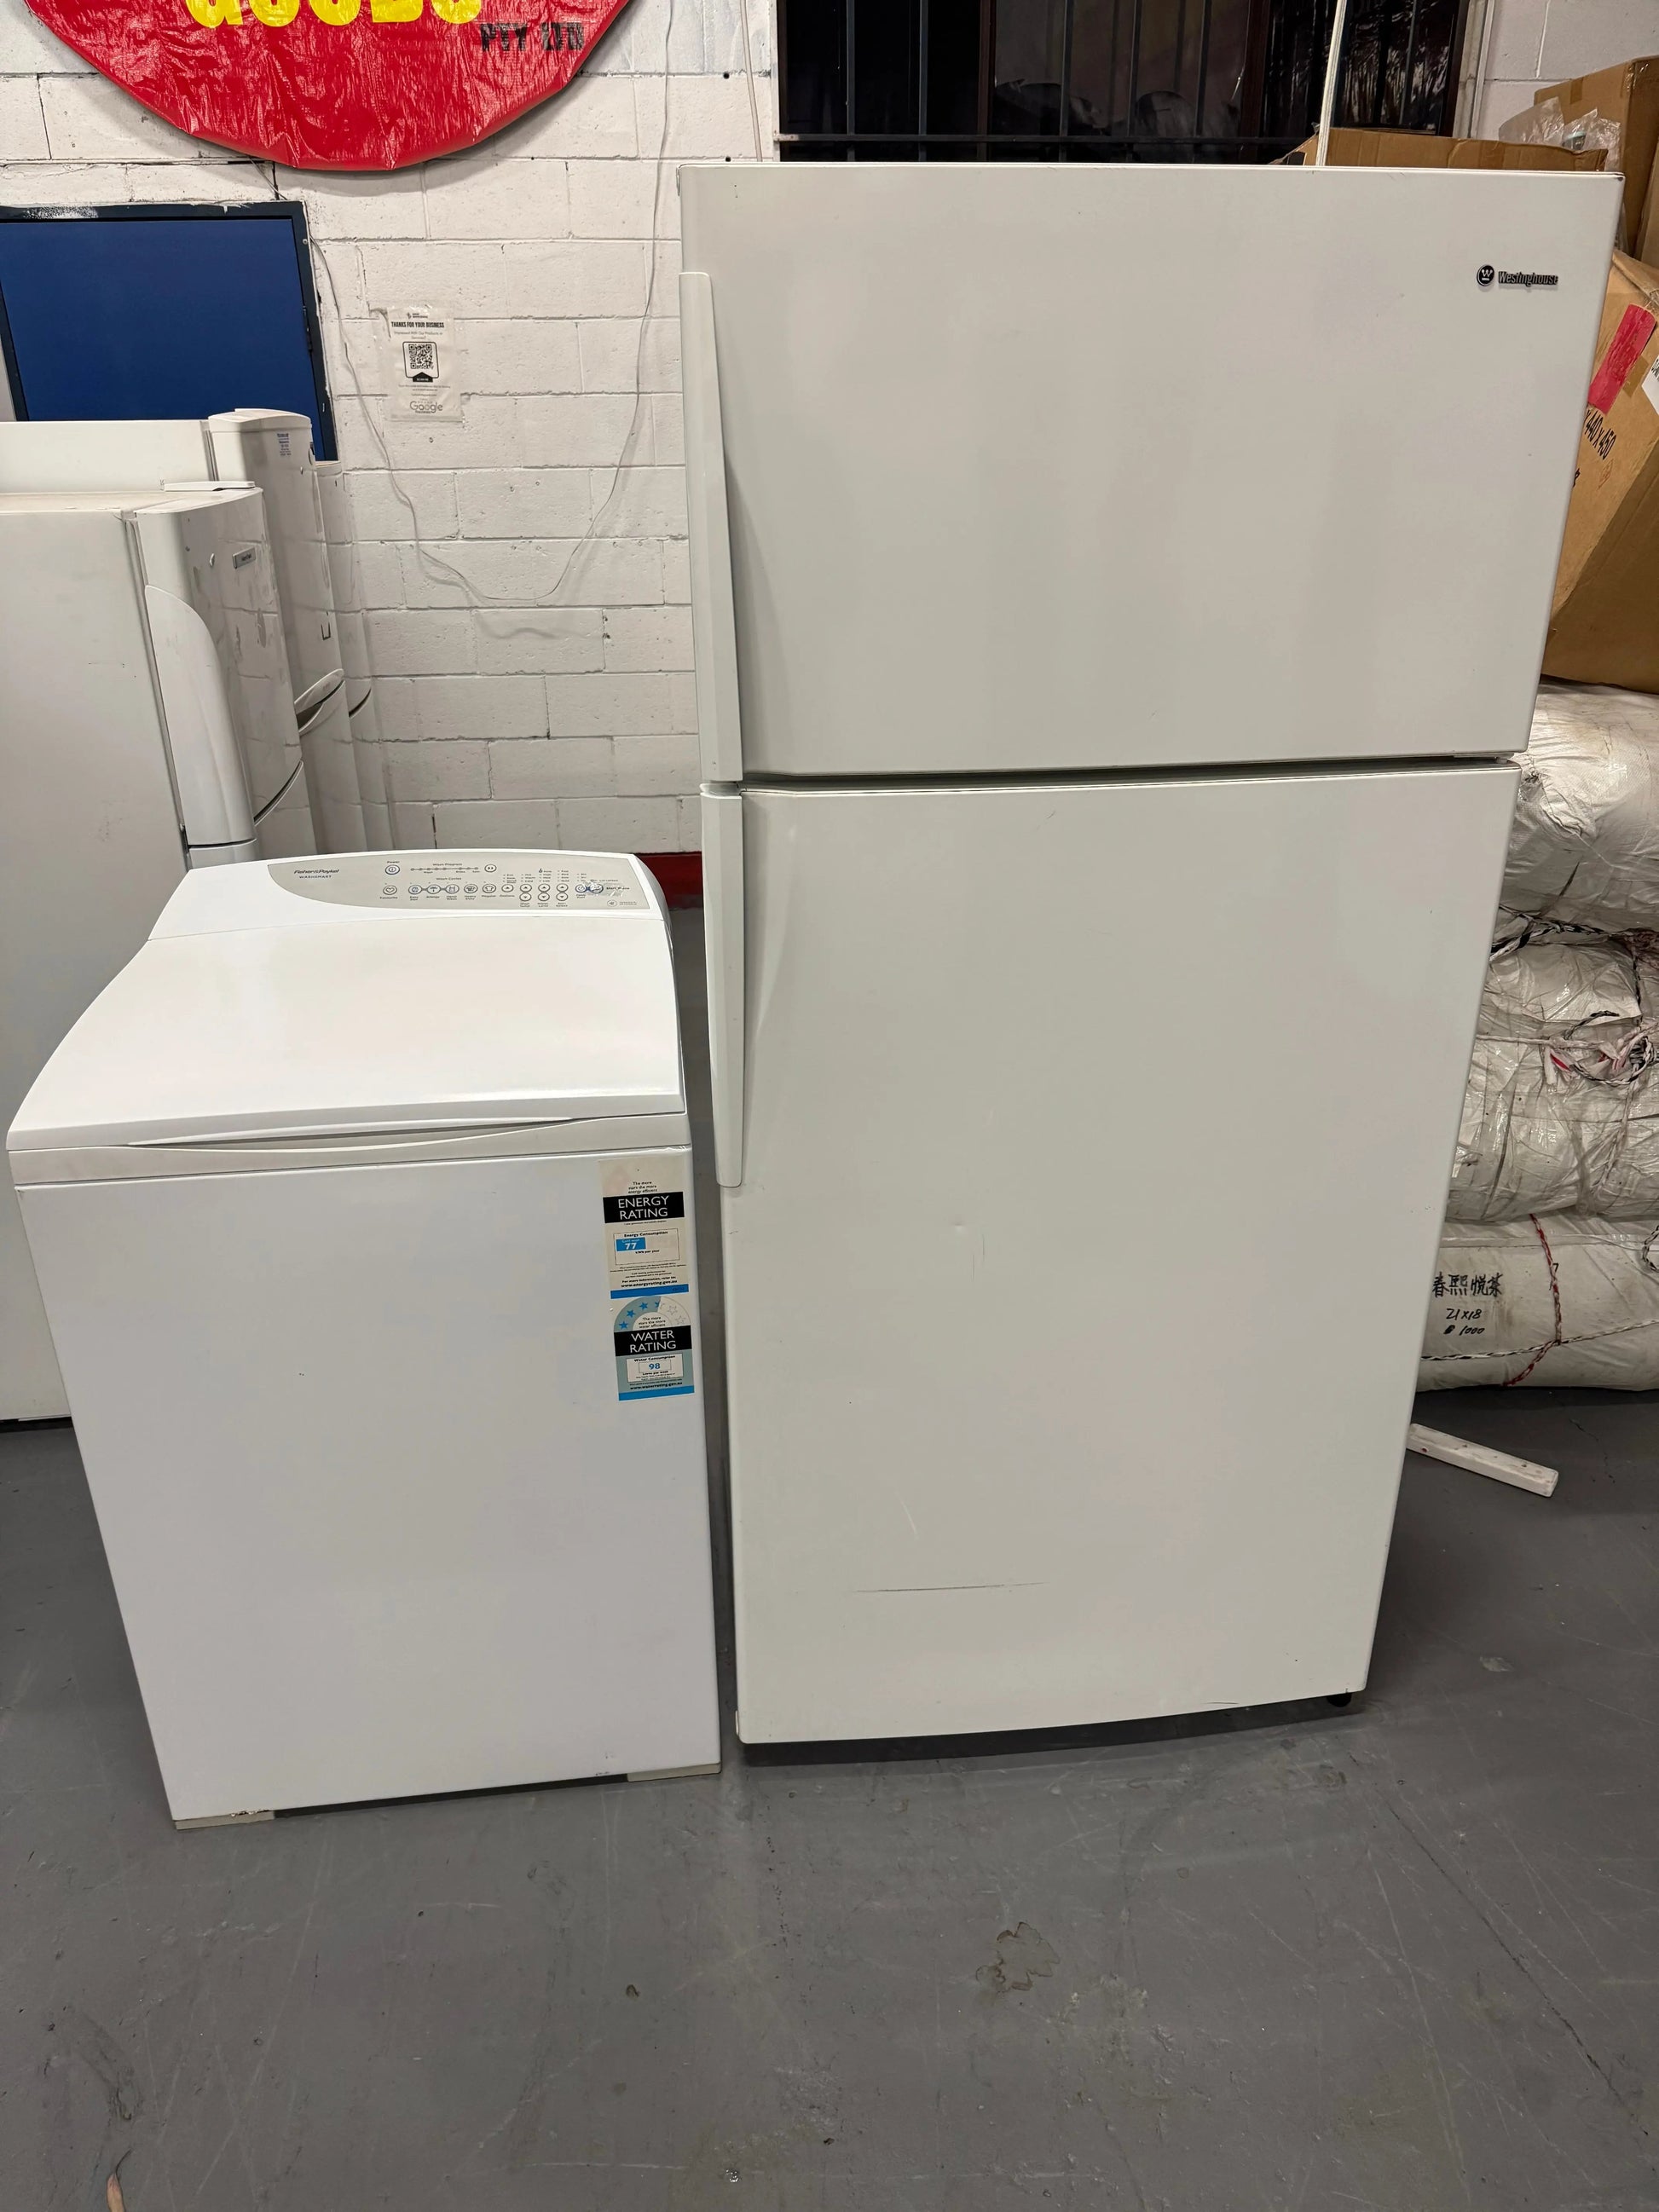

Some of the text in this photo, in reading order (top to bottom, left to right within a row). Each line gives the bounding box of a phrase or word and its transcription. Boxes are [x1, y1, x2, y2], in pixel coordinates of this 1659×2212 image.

[481, 22, 528, 52] PTY
[1498, 270, 1559, 287] Westinghouse
[410, 401, 443, 413] Google
[618, 1195, 669, 1208] ENERGY
[620, 1208, 668, 1220] RATING
[631, 1330, 674, 1342] WATER
[1459, 1325, 1485, 1336] 1000
[630, 1341, 676, 1353] RATING
